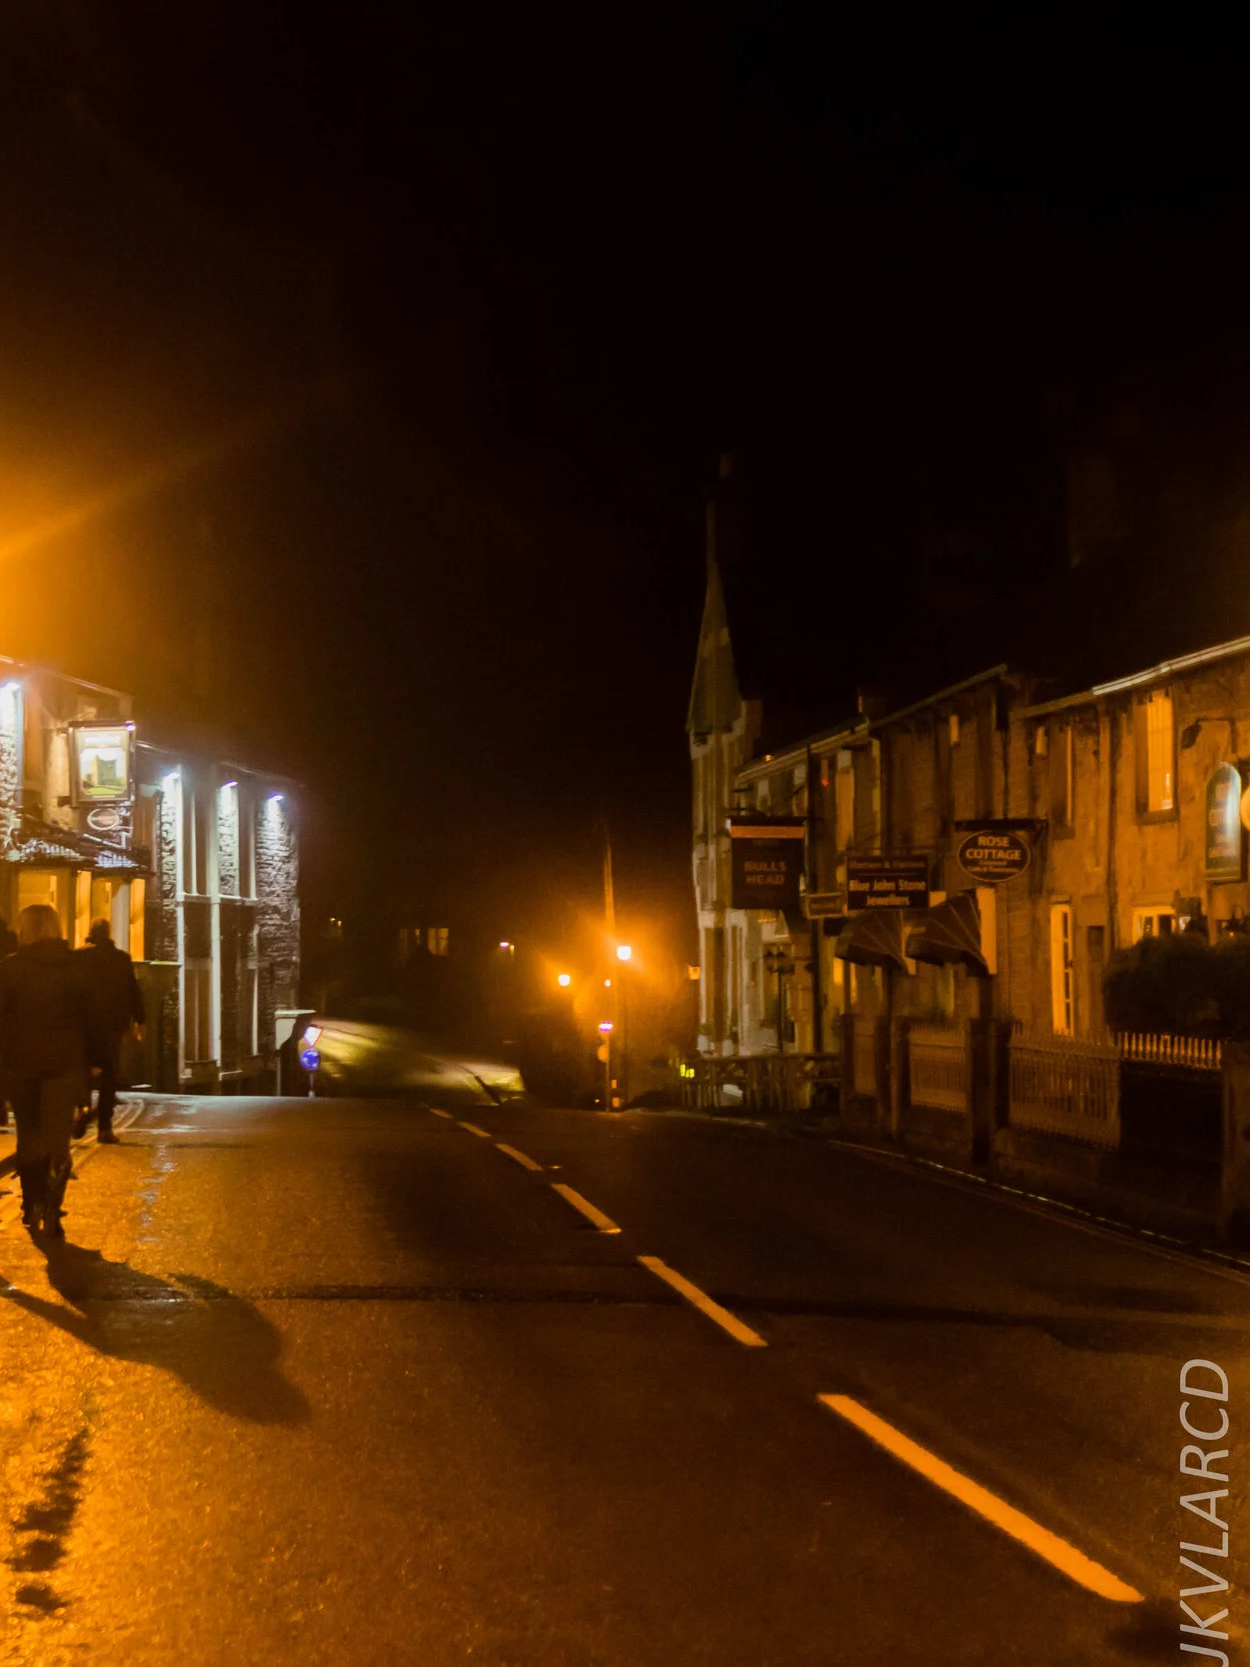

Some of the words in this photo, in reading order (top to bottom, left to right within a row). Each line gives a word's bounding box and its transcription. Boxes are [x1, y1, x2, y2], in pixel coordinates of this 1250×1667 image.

[977, 836, 1010, 847] ROSE
[966, 848, 1022, 860] COTTAGE
[745, 874, 785, 885] HEAD
[849, 878, 870, 891] Blue
[872, 878, 896, 891] John
[898, 878, 926, 891] Stone
[866, 893, 910, 906] Jewellers
